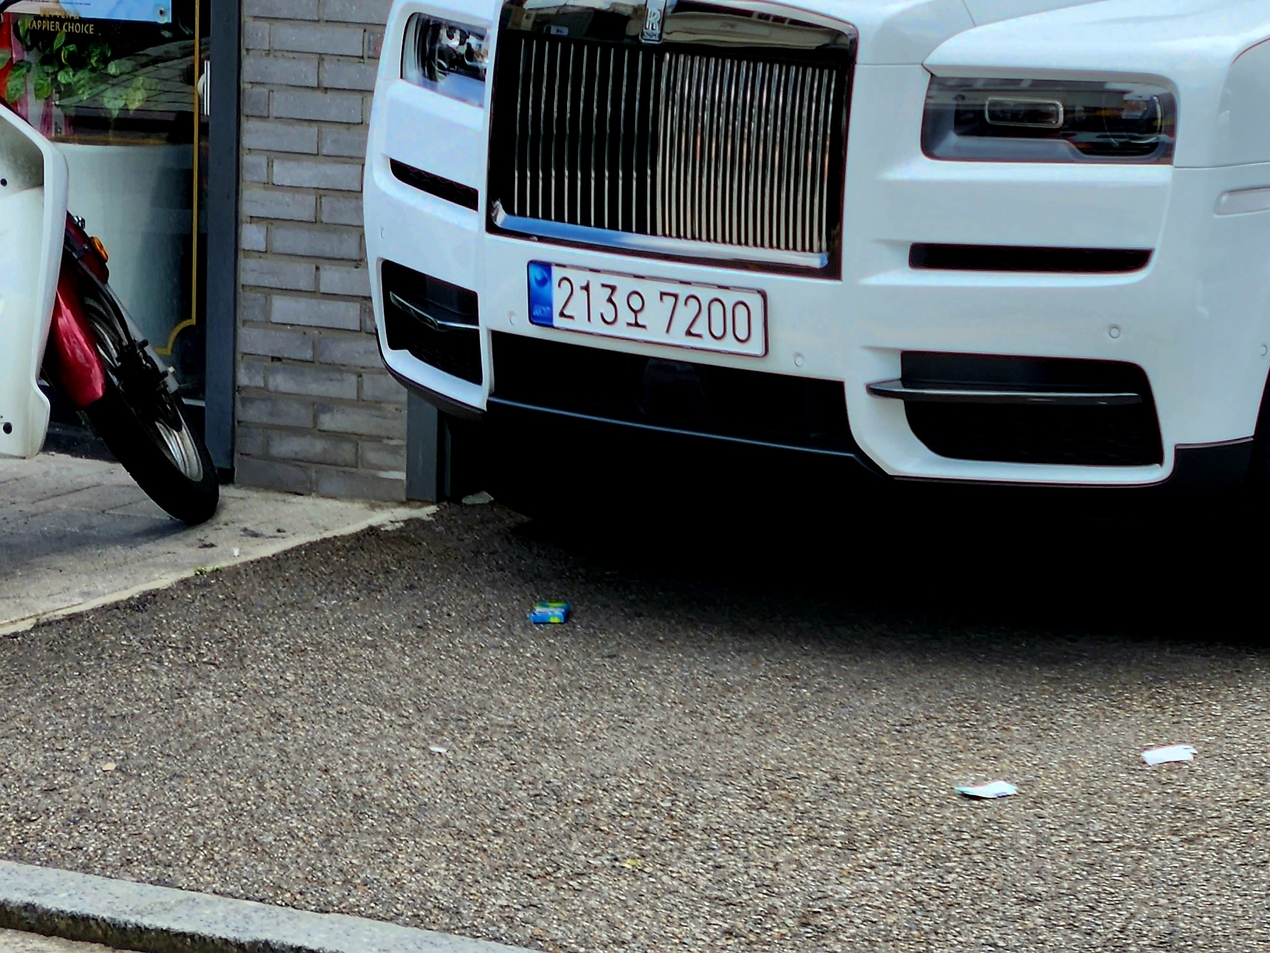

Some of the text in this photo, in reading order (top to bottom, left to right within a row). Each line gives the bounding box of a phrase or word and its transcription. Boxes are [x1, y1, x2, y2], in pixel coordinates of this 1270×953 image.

[62, 21, 95, 35] CHOICE
[557, 276, 752, 344] 213오 7200
